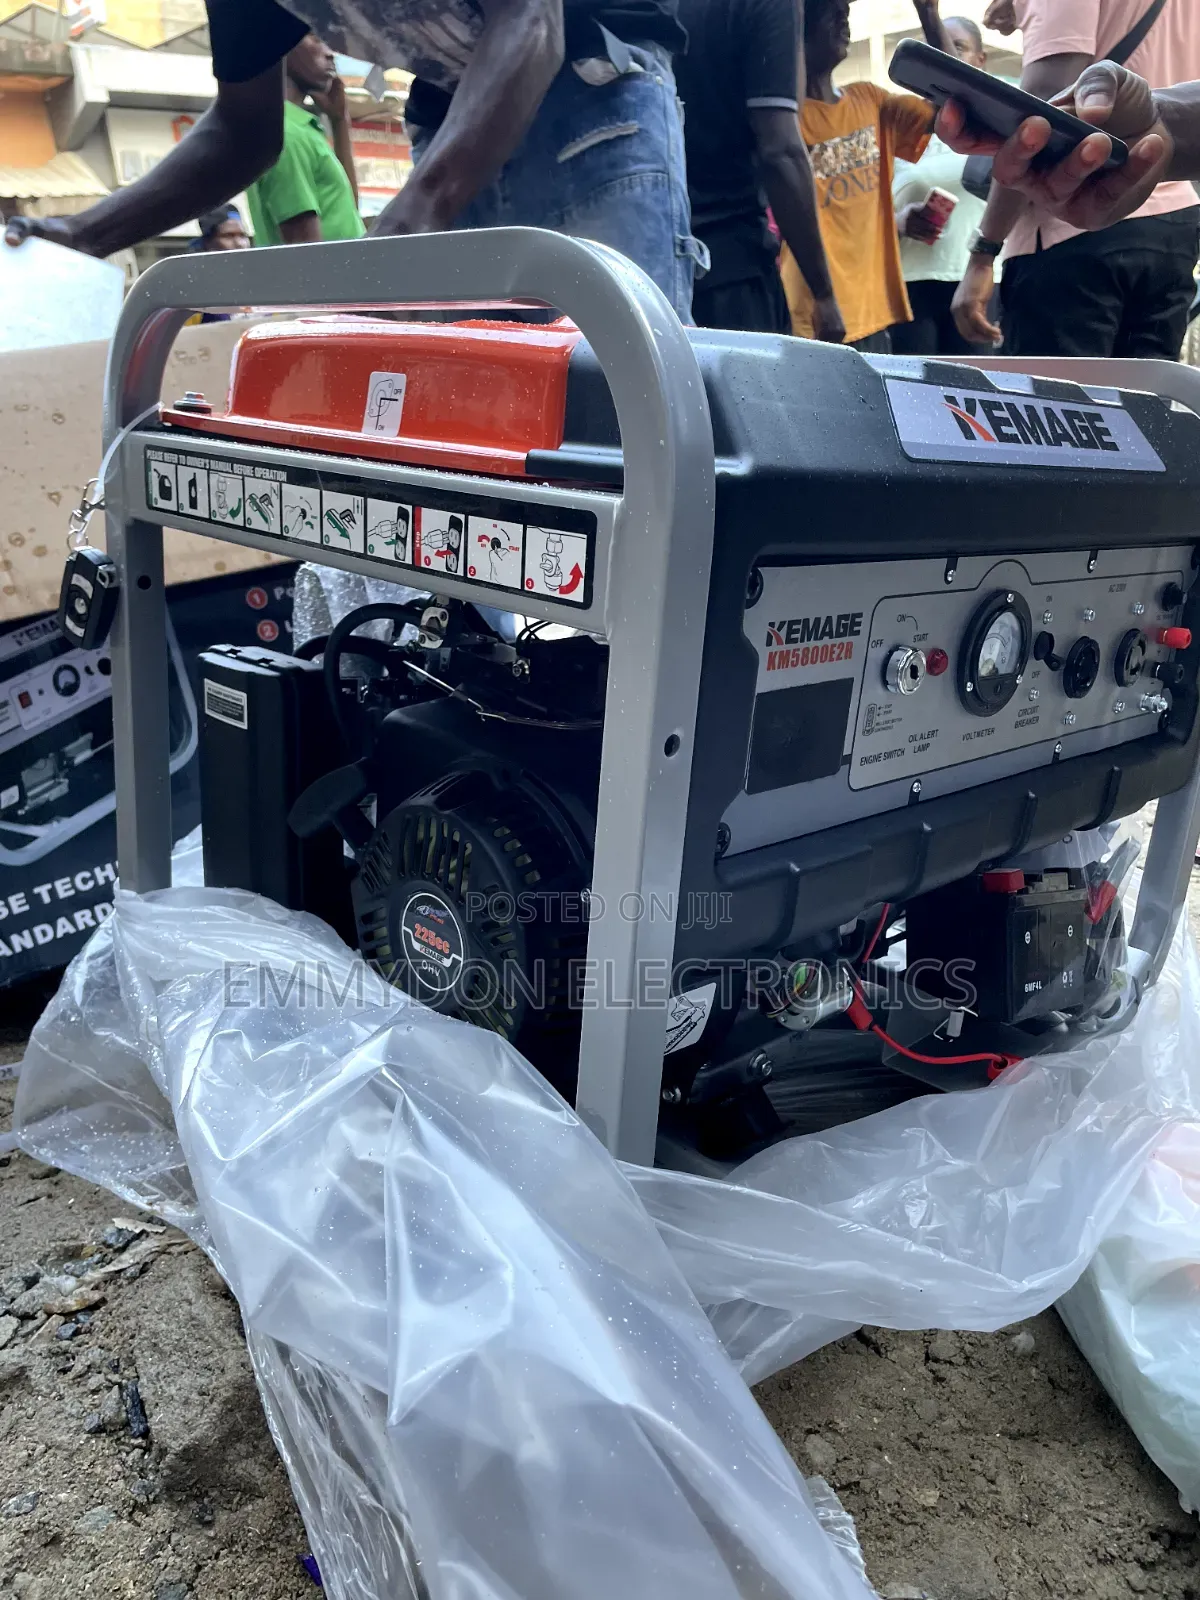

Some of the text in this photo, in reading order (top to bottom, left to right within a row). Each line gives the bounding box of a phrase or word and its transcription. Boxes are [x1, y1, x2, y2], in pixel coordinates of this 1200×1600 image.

[941, 395, 1120, 452] KEMAGE
[146, 449, 164, 461] PLEASE
[233, 464, 254, 477] BEFORE
[255, 467, 288, 482] OPERATION
[897, 614, 907, 623] ON
[766, 612, 864, 647] KEMAGE
[871, 639, 884, 649] OFF
[913, 633, 929, 643] START
[767, 641, 853, 671] KM5800E2R
[1031, 671, 1041, 679] OFF
[1018, 705, 1039, 717] CIRCUIT
[1014, 716, 1039, 729] BREAKER
[908, 729, 939, 743] OIL ALERT
[962, 727, 996, 741] VOLTMETER
[913, 743, 931, 754] LAMP
[860, 748, 905, 767] ENGINE SWITCH
[414, 923, 450, 954] 225cc
[421, 959, 441, 977] OHV
